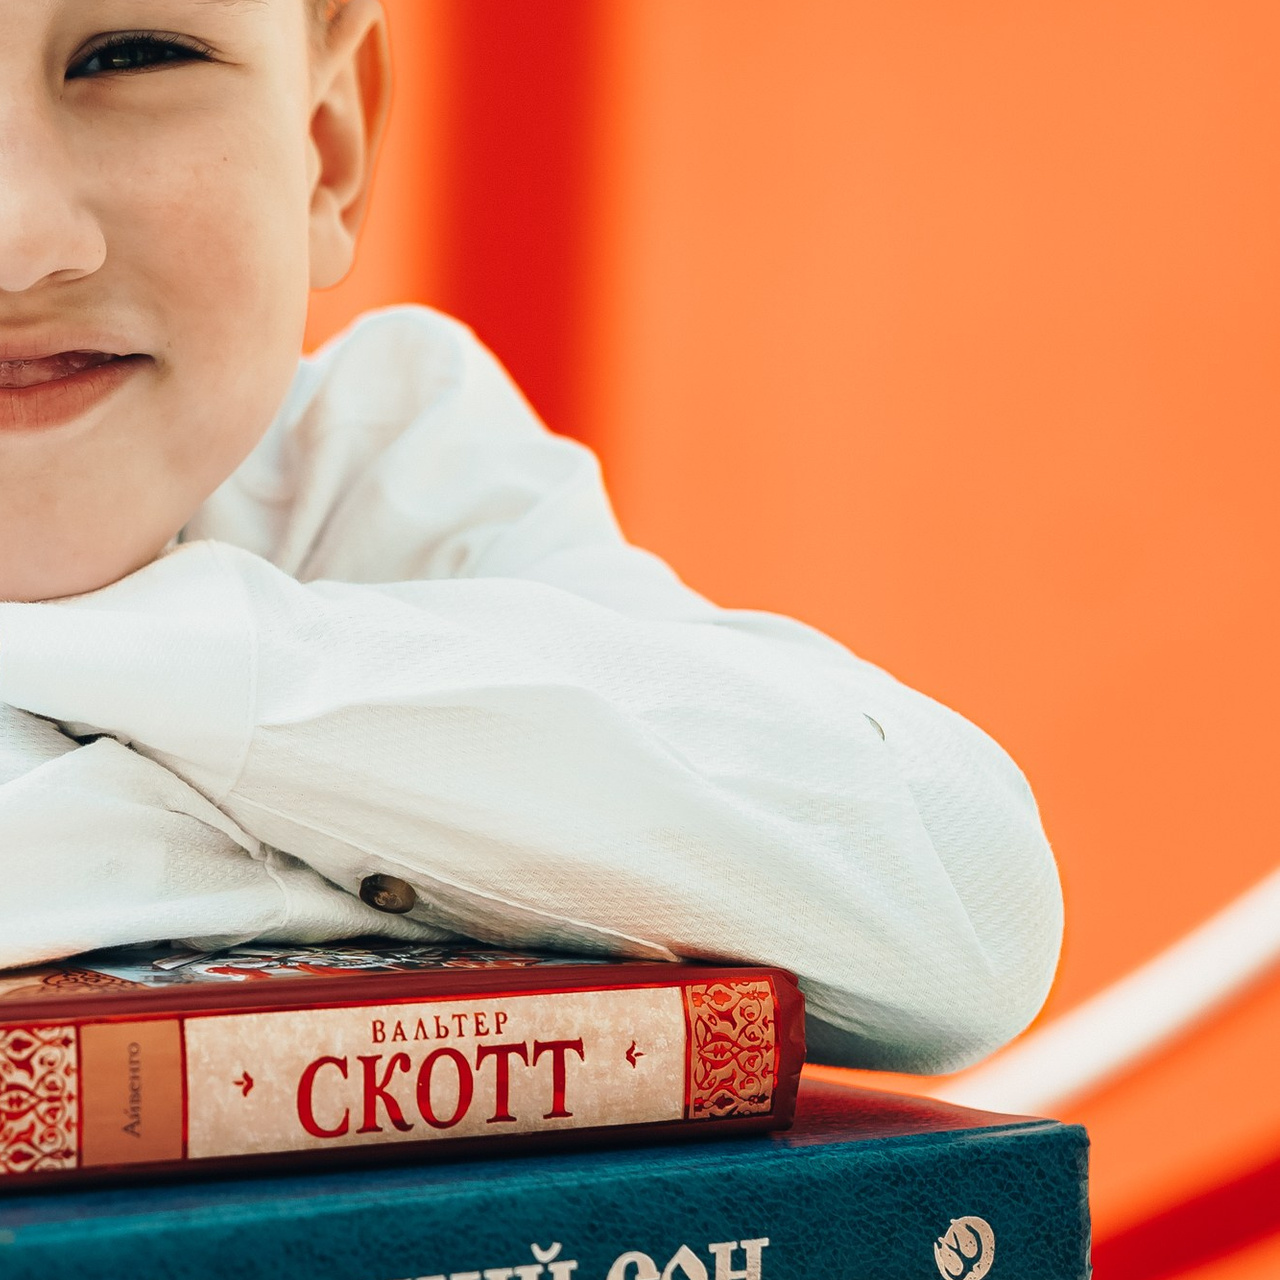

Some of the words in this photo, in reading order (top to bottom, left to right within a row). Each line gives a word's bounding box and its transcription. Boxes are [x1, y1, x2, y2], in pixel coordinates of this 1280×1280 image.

[372, 1011, 508, 1044] ВАЛЬТЕР
[121, 1041, 141, 1138] Айвенго
[296, 1037, 585, 1139] СКОТТ
